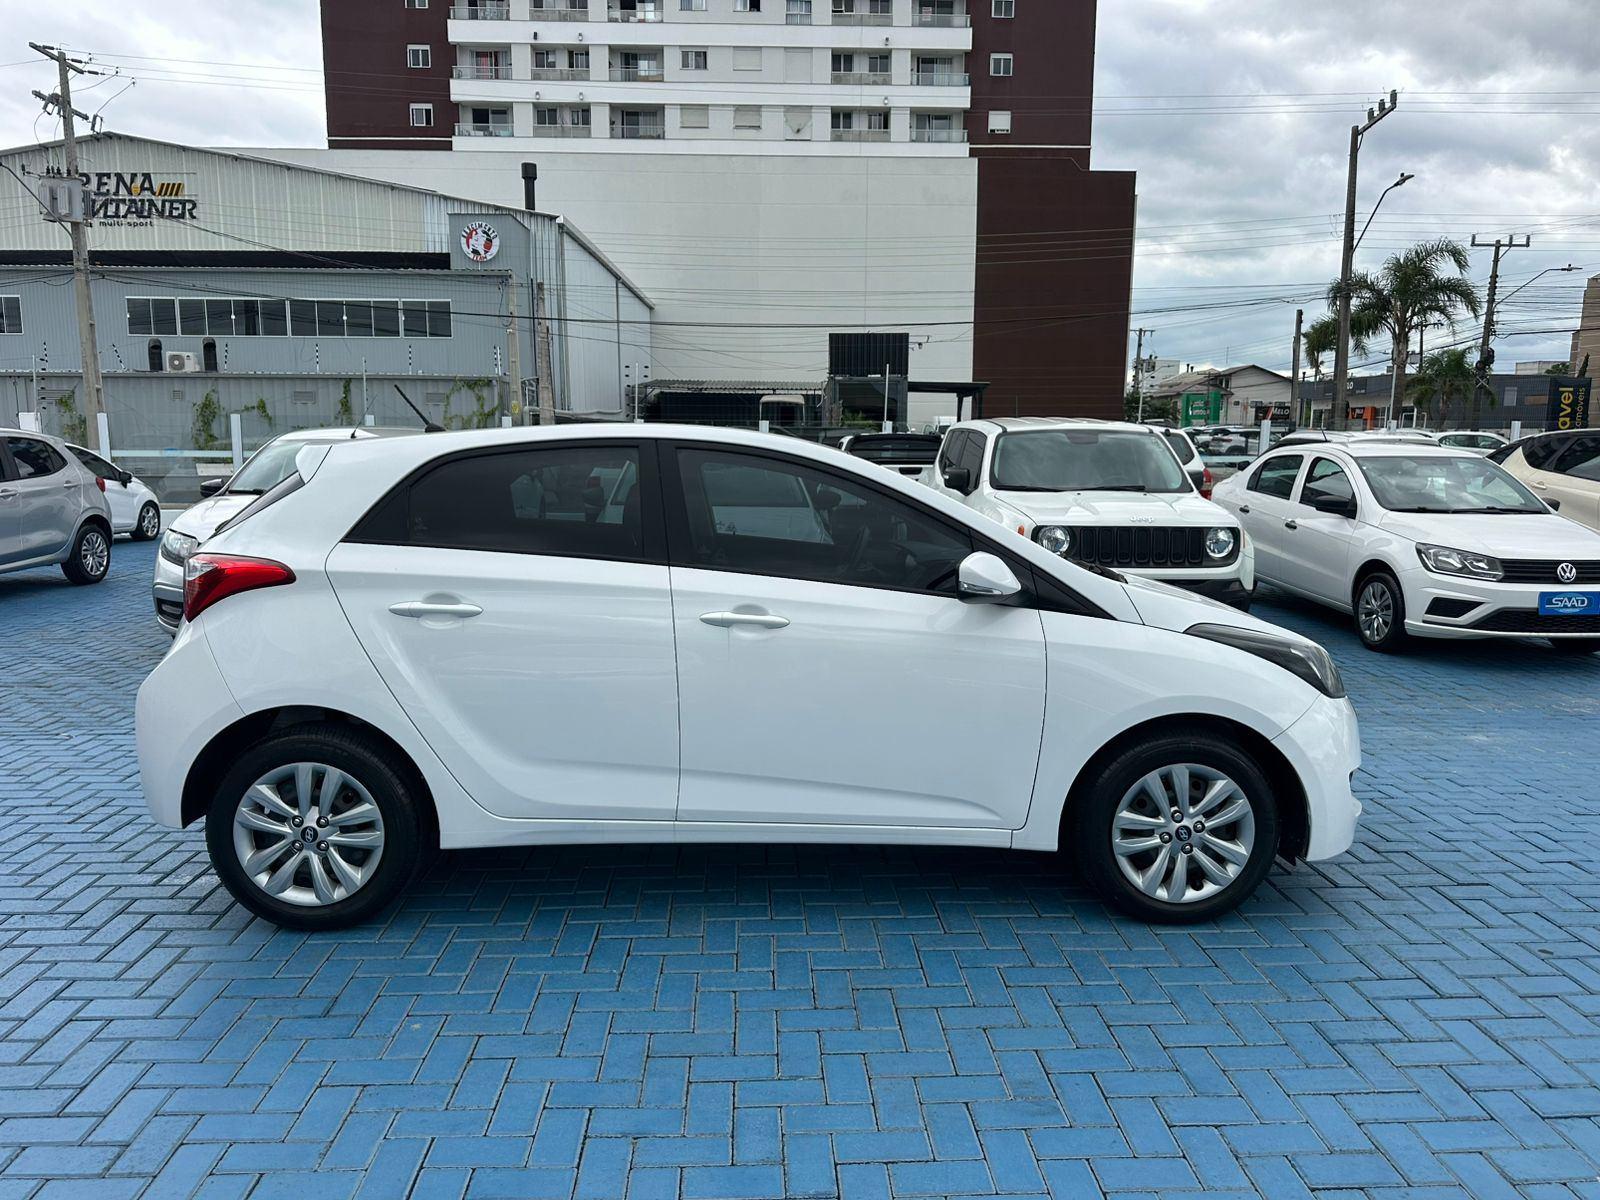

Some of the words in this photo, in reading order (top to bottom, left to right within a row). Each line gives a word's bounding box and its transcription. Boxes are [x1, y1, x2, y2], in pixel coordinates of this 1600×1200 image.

[79, 172, 156, 196] RENA
[91, 198, 197, 219] NTAINER
[1545, 597, 1588, 608] SAAD
